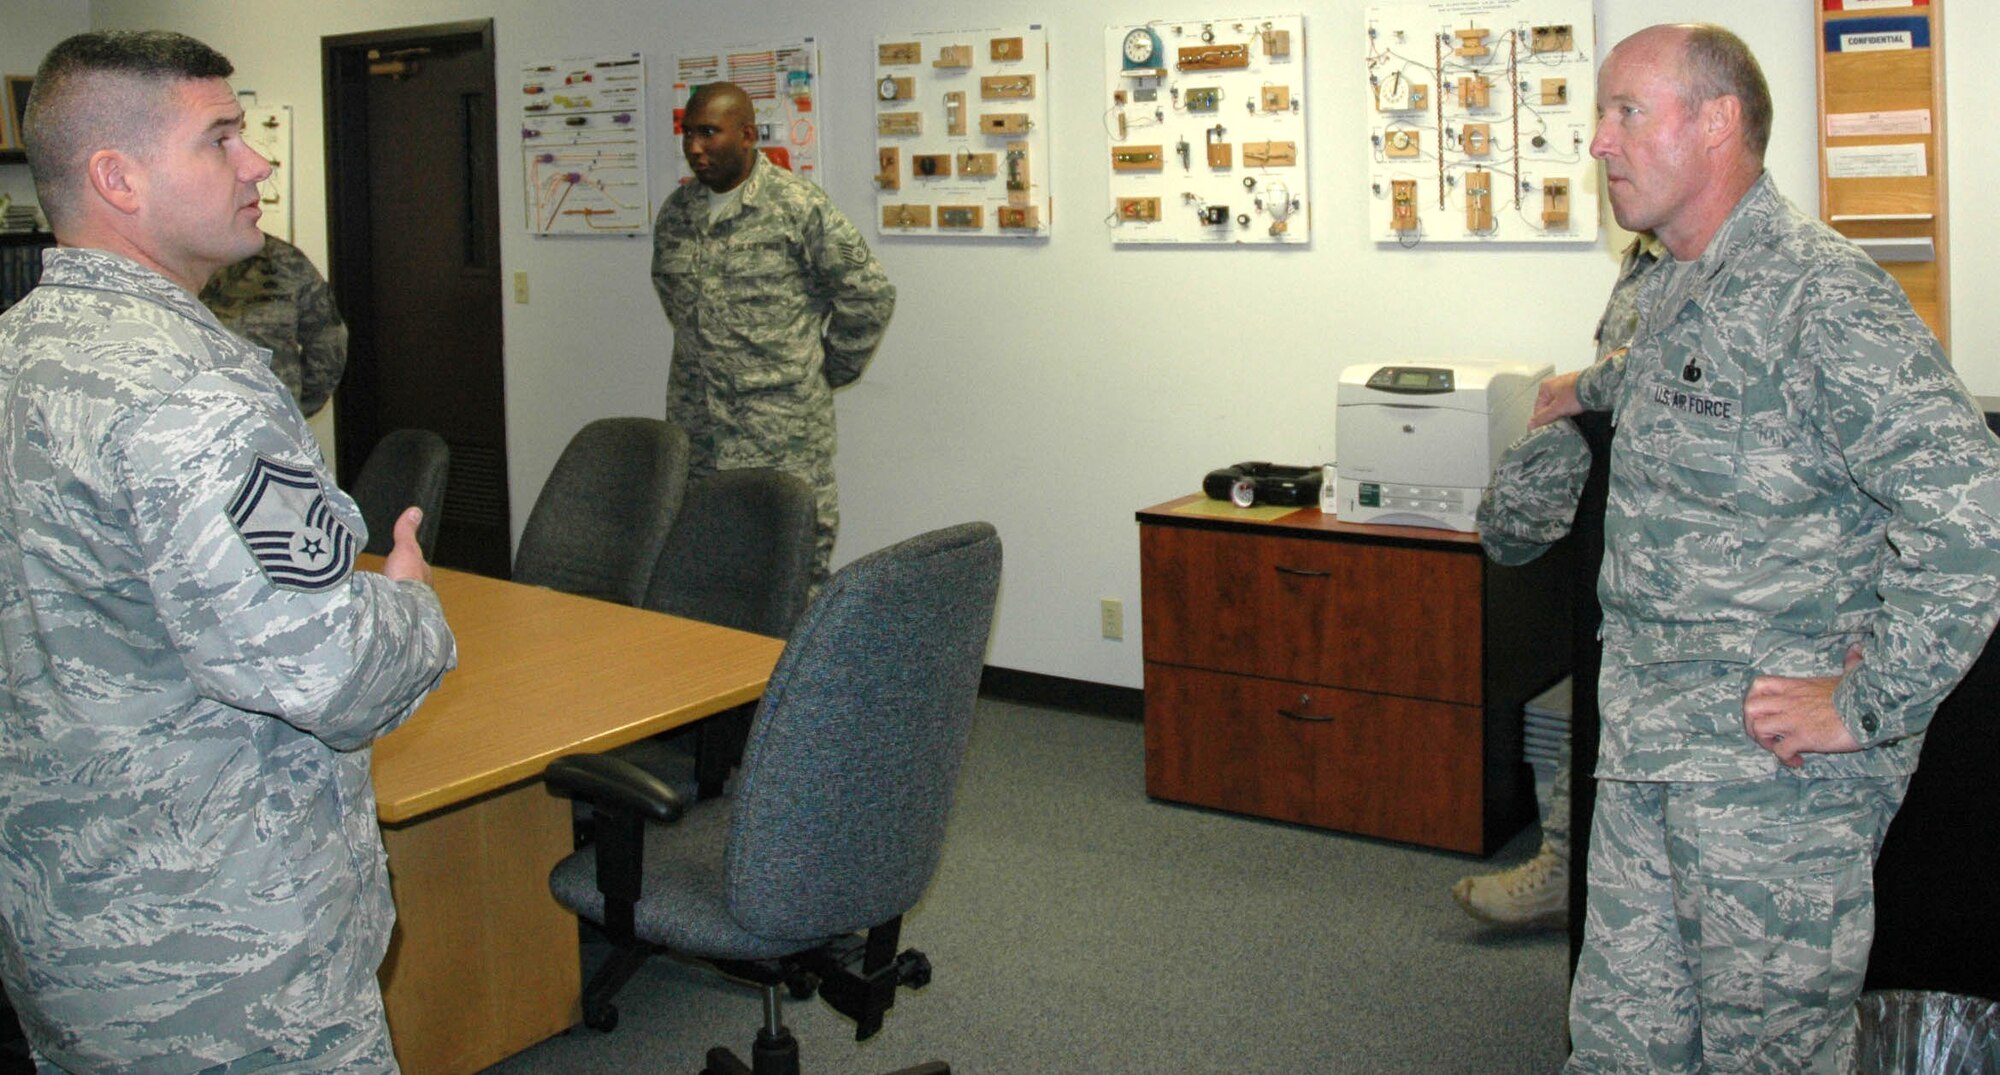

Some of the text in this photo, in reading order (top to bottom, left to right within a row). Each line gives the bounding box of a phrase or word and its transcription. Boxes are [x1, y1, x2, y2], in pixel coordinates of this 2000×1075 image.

[1848, 34, 1904, 45] CONFIDENTIAL
[1655, 386, 1670, 406] U.S.
[1689, 396, 1732, 418] FORCE
